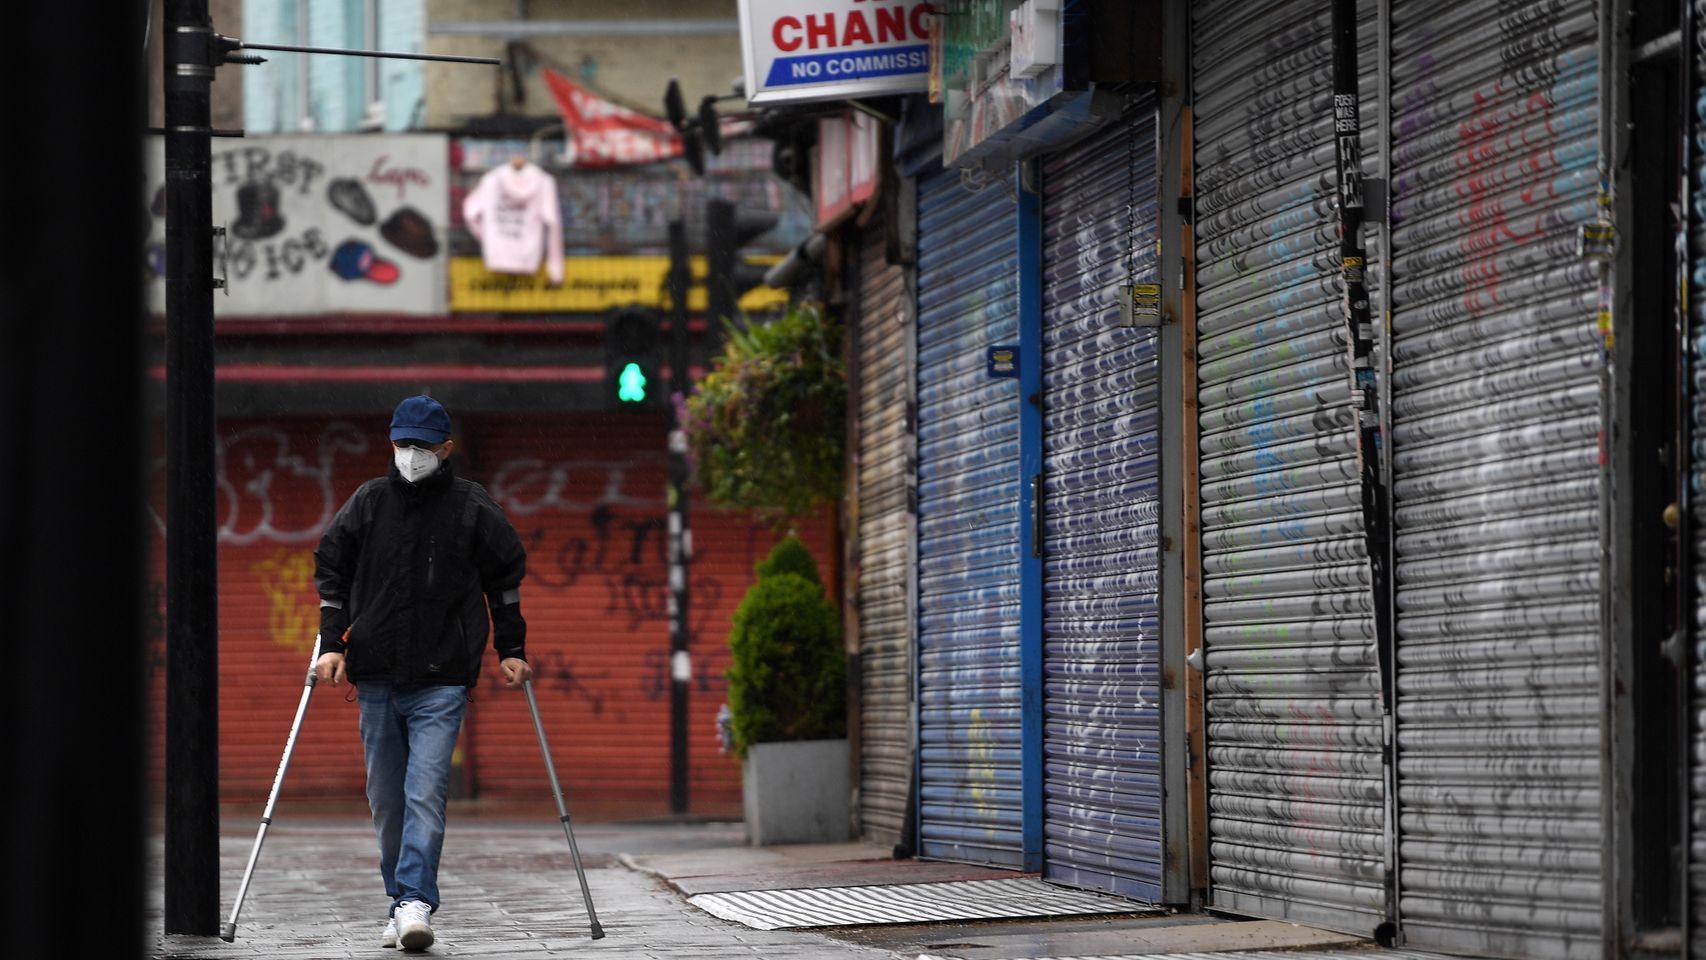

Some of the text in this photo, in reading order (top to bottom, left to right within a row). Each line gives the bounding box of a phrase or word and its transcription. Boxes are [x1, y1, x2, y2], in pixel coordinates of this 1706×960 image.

[792, 61, 821, 78] NO
[1336, 106, 1354, 118] WAS
[1336, 119, 1357, 132] HERE
[211, 147, 324, 196] IRST
